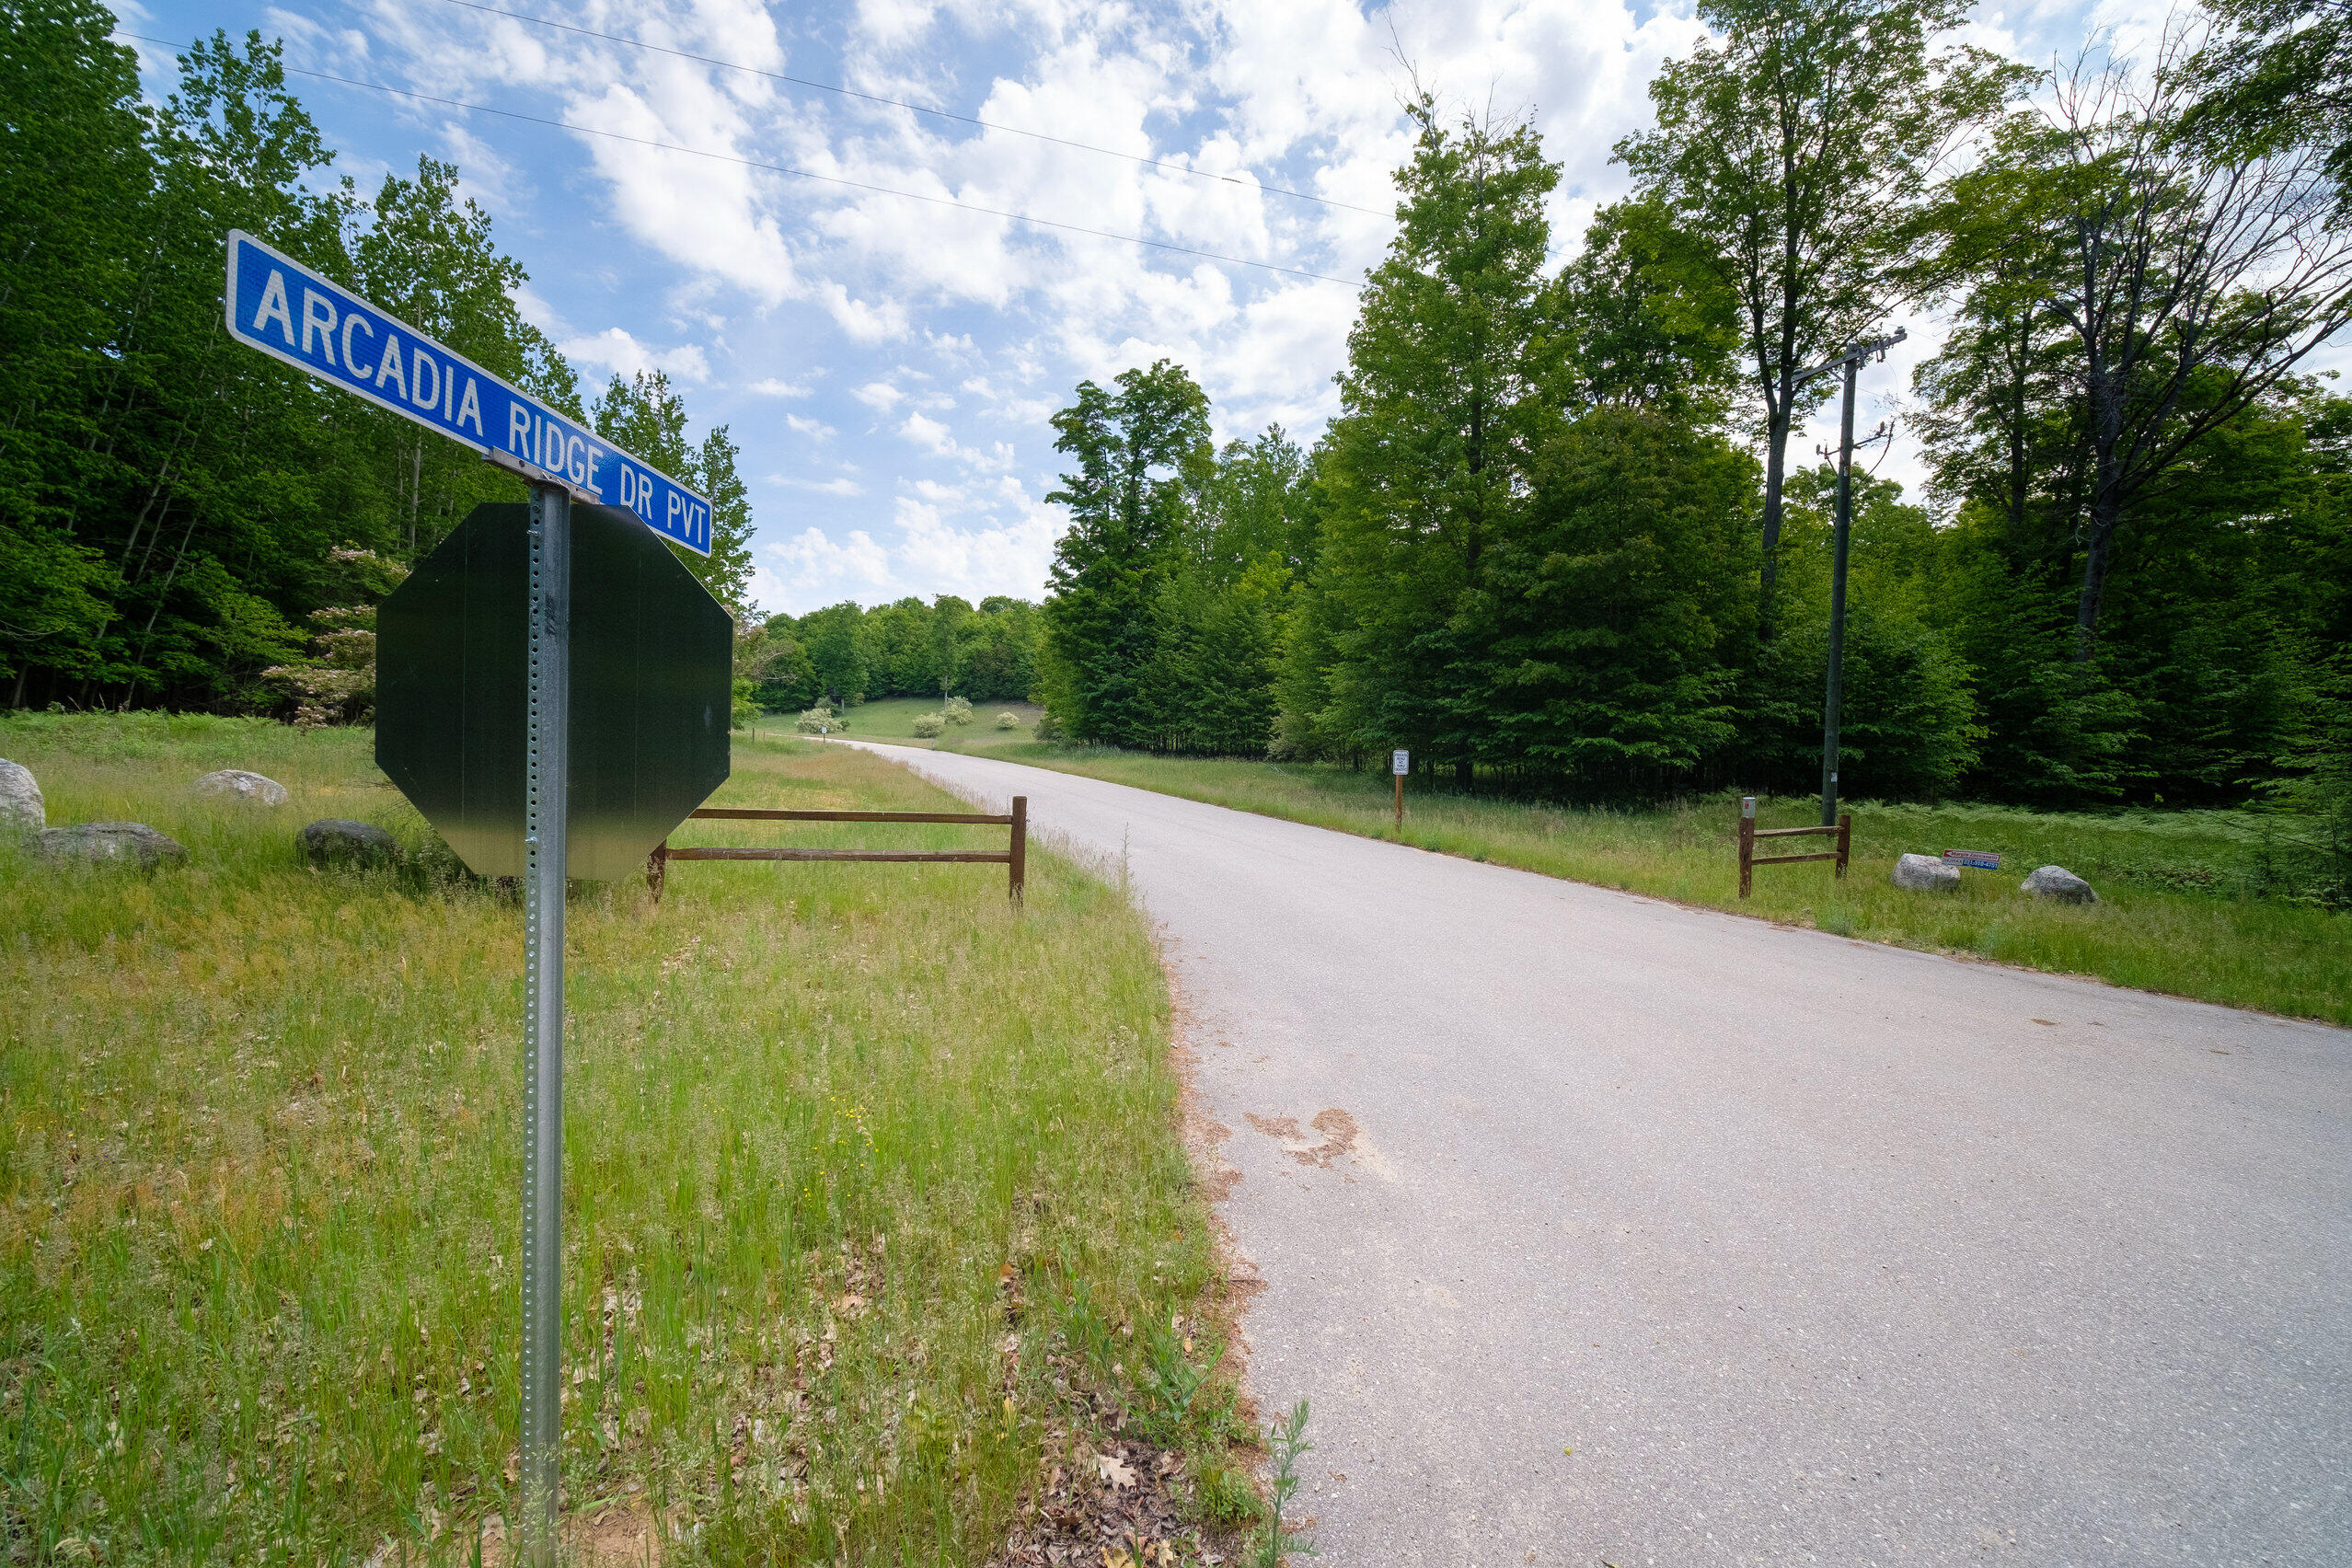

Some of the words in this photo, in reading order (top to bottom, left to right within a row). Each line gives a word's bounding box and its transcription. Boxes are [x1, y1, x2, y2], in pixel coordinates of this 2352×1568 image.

[253, 269, 483, 437] ARCADIA
[509, 400, 603, 495] RIDGE
[620, 463, 653, 520] DR
[667, 490, 706, 544] PVT
